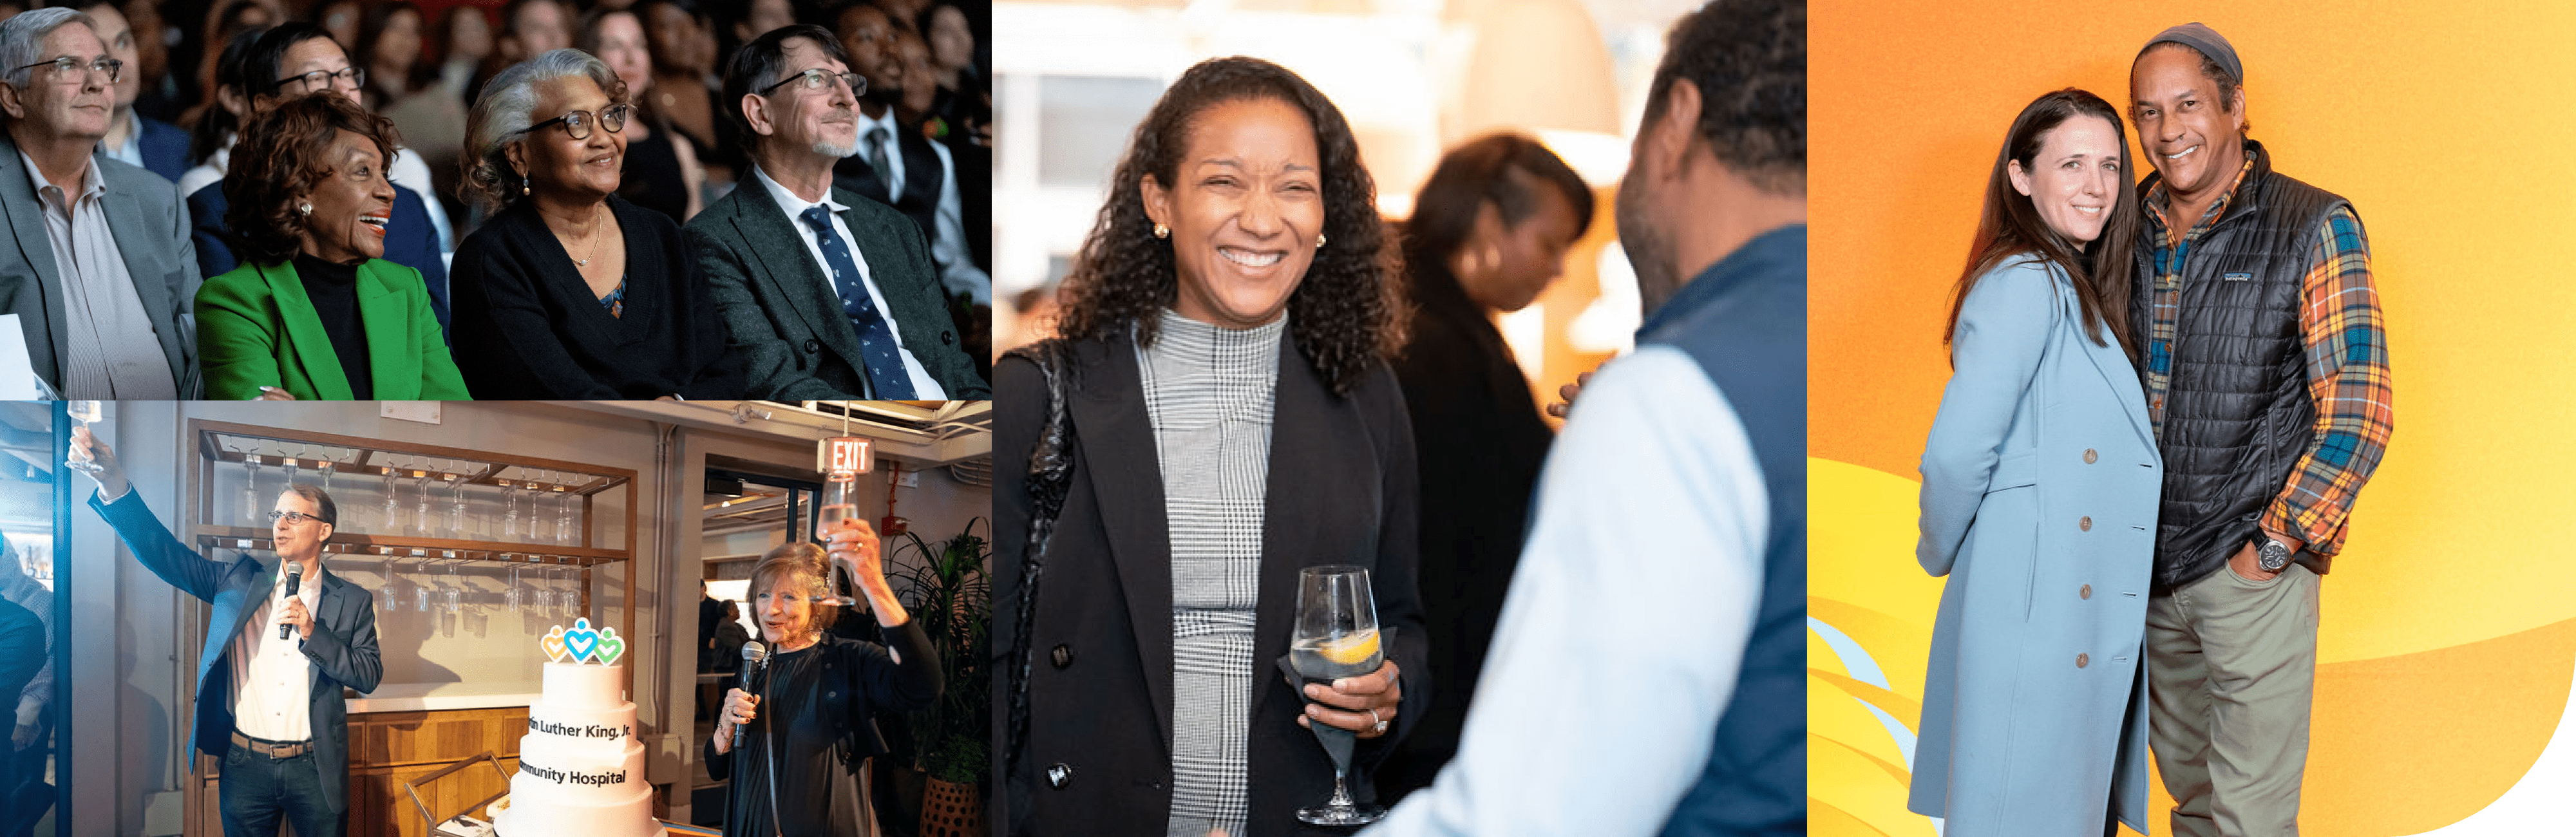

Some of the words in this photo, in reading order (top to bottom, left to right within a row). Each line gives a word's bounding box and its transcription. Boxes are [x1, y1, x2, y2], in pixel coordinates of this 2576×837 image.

[833, 441, 869, 470] EXIT
[540, 719, 582, 737] Luther
[586, 724, 620, 741] King,
[621, 724, 630, 737] Jr.
[569, 769, 626, 788] Hospital
